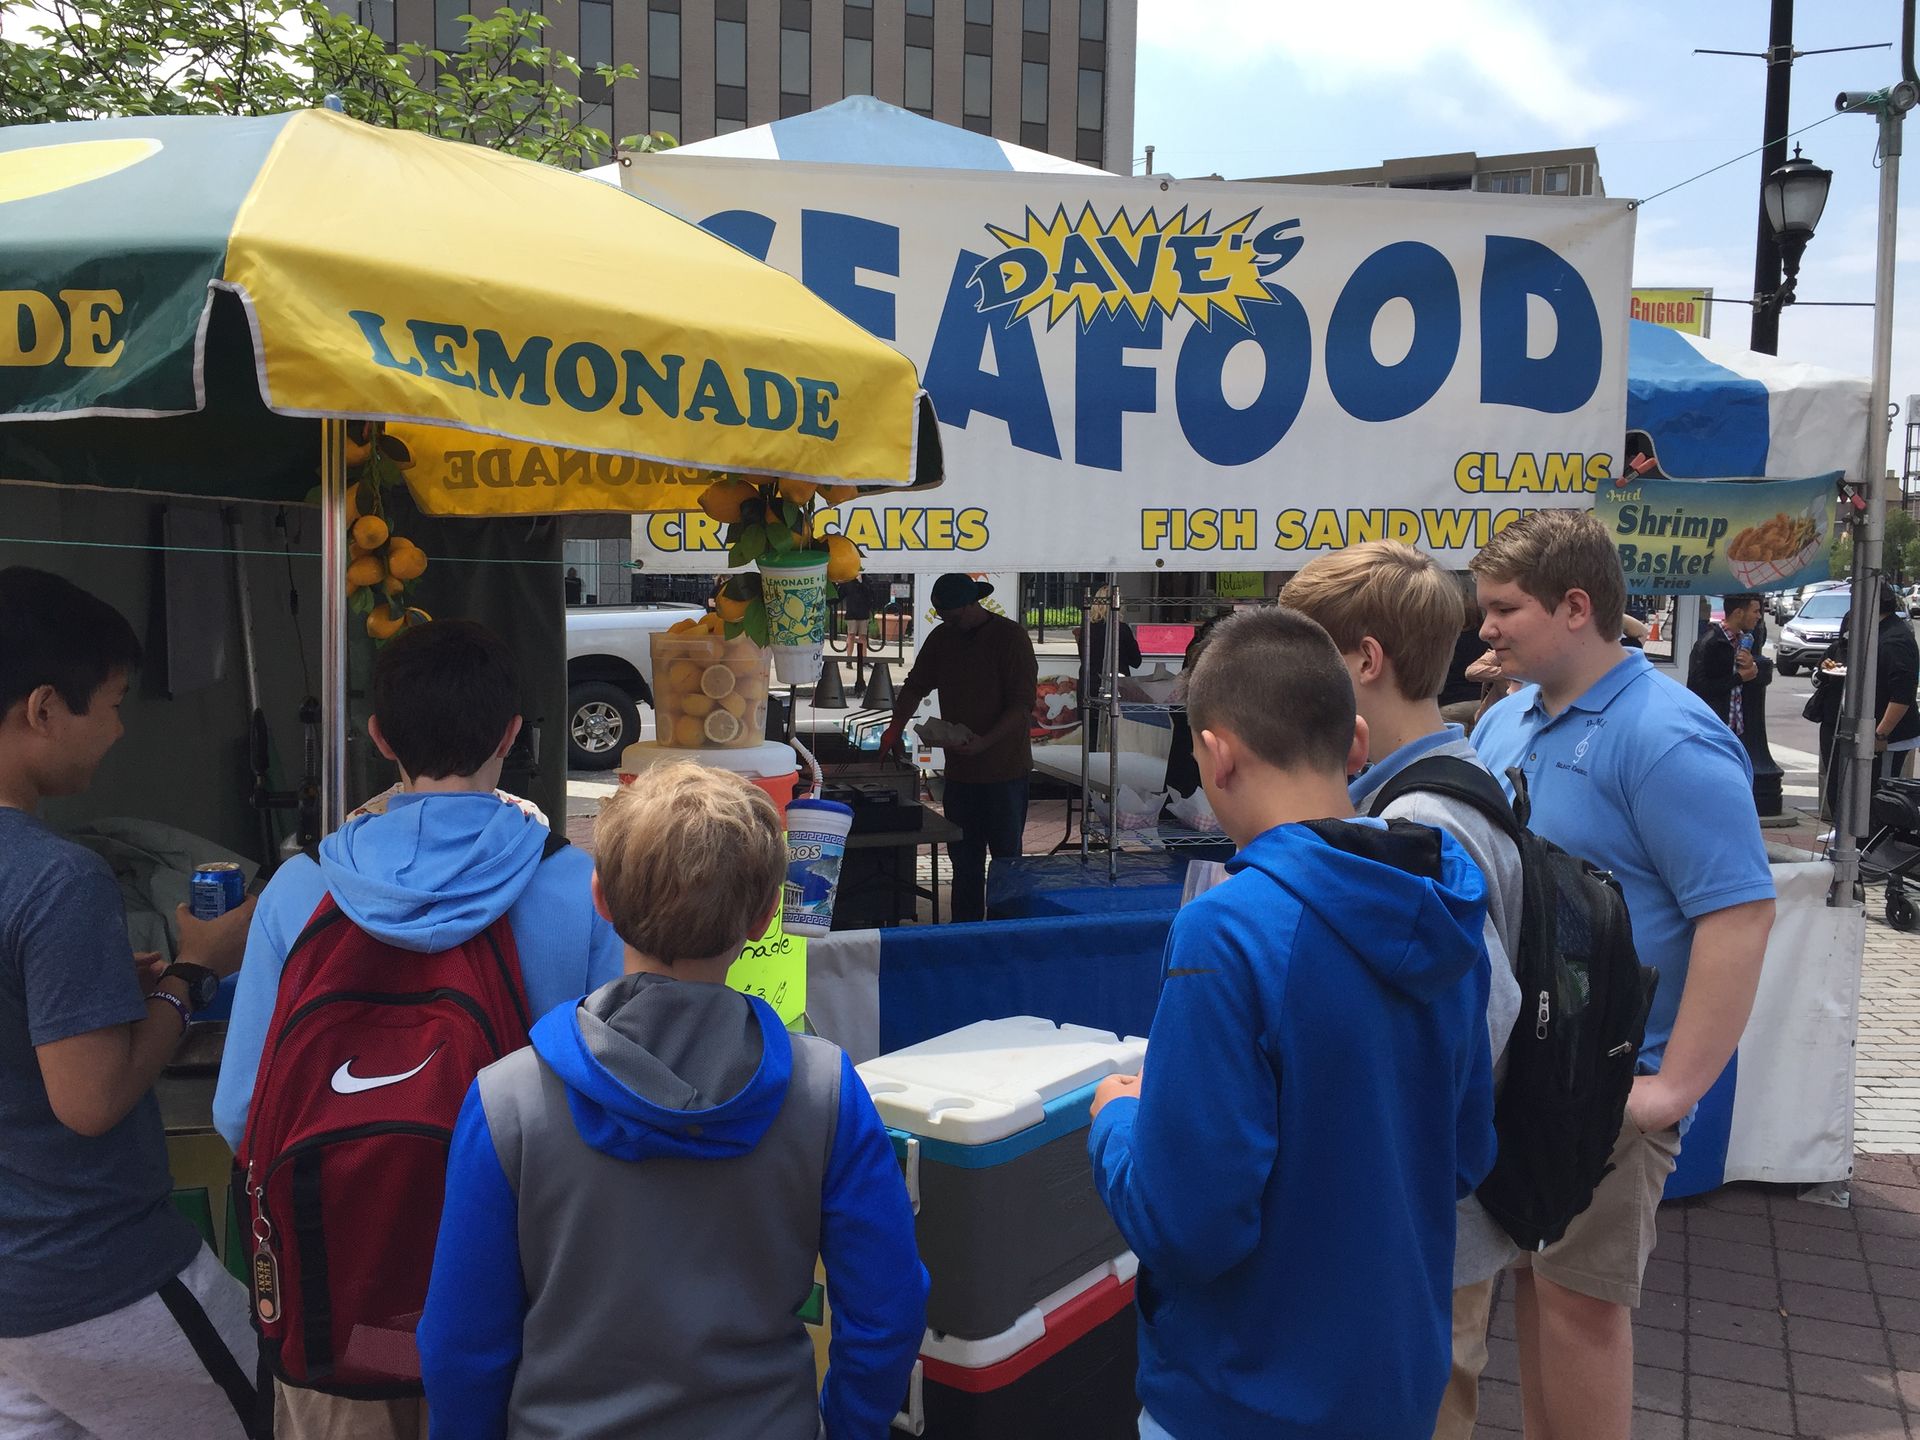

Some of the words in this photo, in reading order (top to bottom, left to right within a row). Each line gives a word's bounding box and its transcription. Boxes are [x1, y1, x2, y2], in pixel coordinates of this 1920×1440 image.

[967, 217, 1304, 312] DAVE'S
[348, 310, 840, 441] LEMONADE
[1454, 452, 1612, 493] CLAMS
[1606, 487, 1642, 503] Fried
[811, 507, 990, 551] CAKES
[1141, 508, 1258, 551] FISH
[1275, 508, 1596, 551] SANDWI
[1616, 503, 1729, 549] Shrimp
[1617, 543, 1715, 575] Basket
[766, 576, 815, 588] LEMONADE
[1652, 576, 1692, 590] Fries
[155, 991, 181, 1007] ALONE
